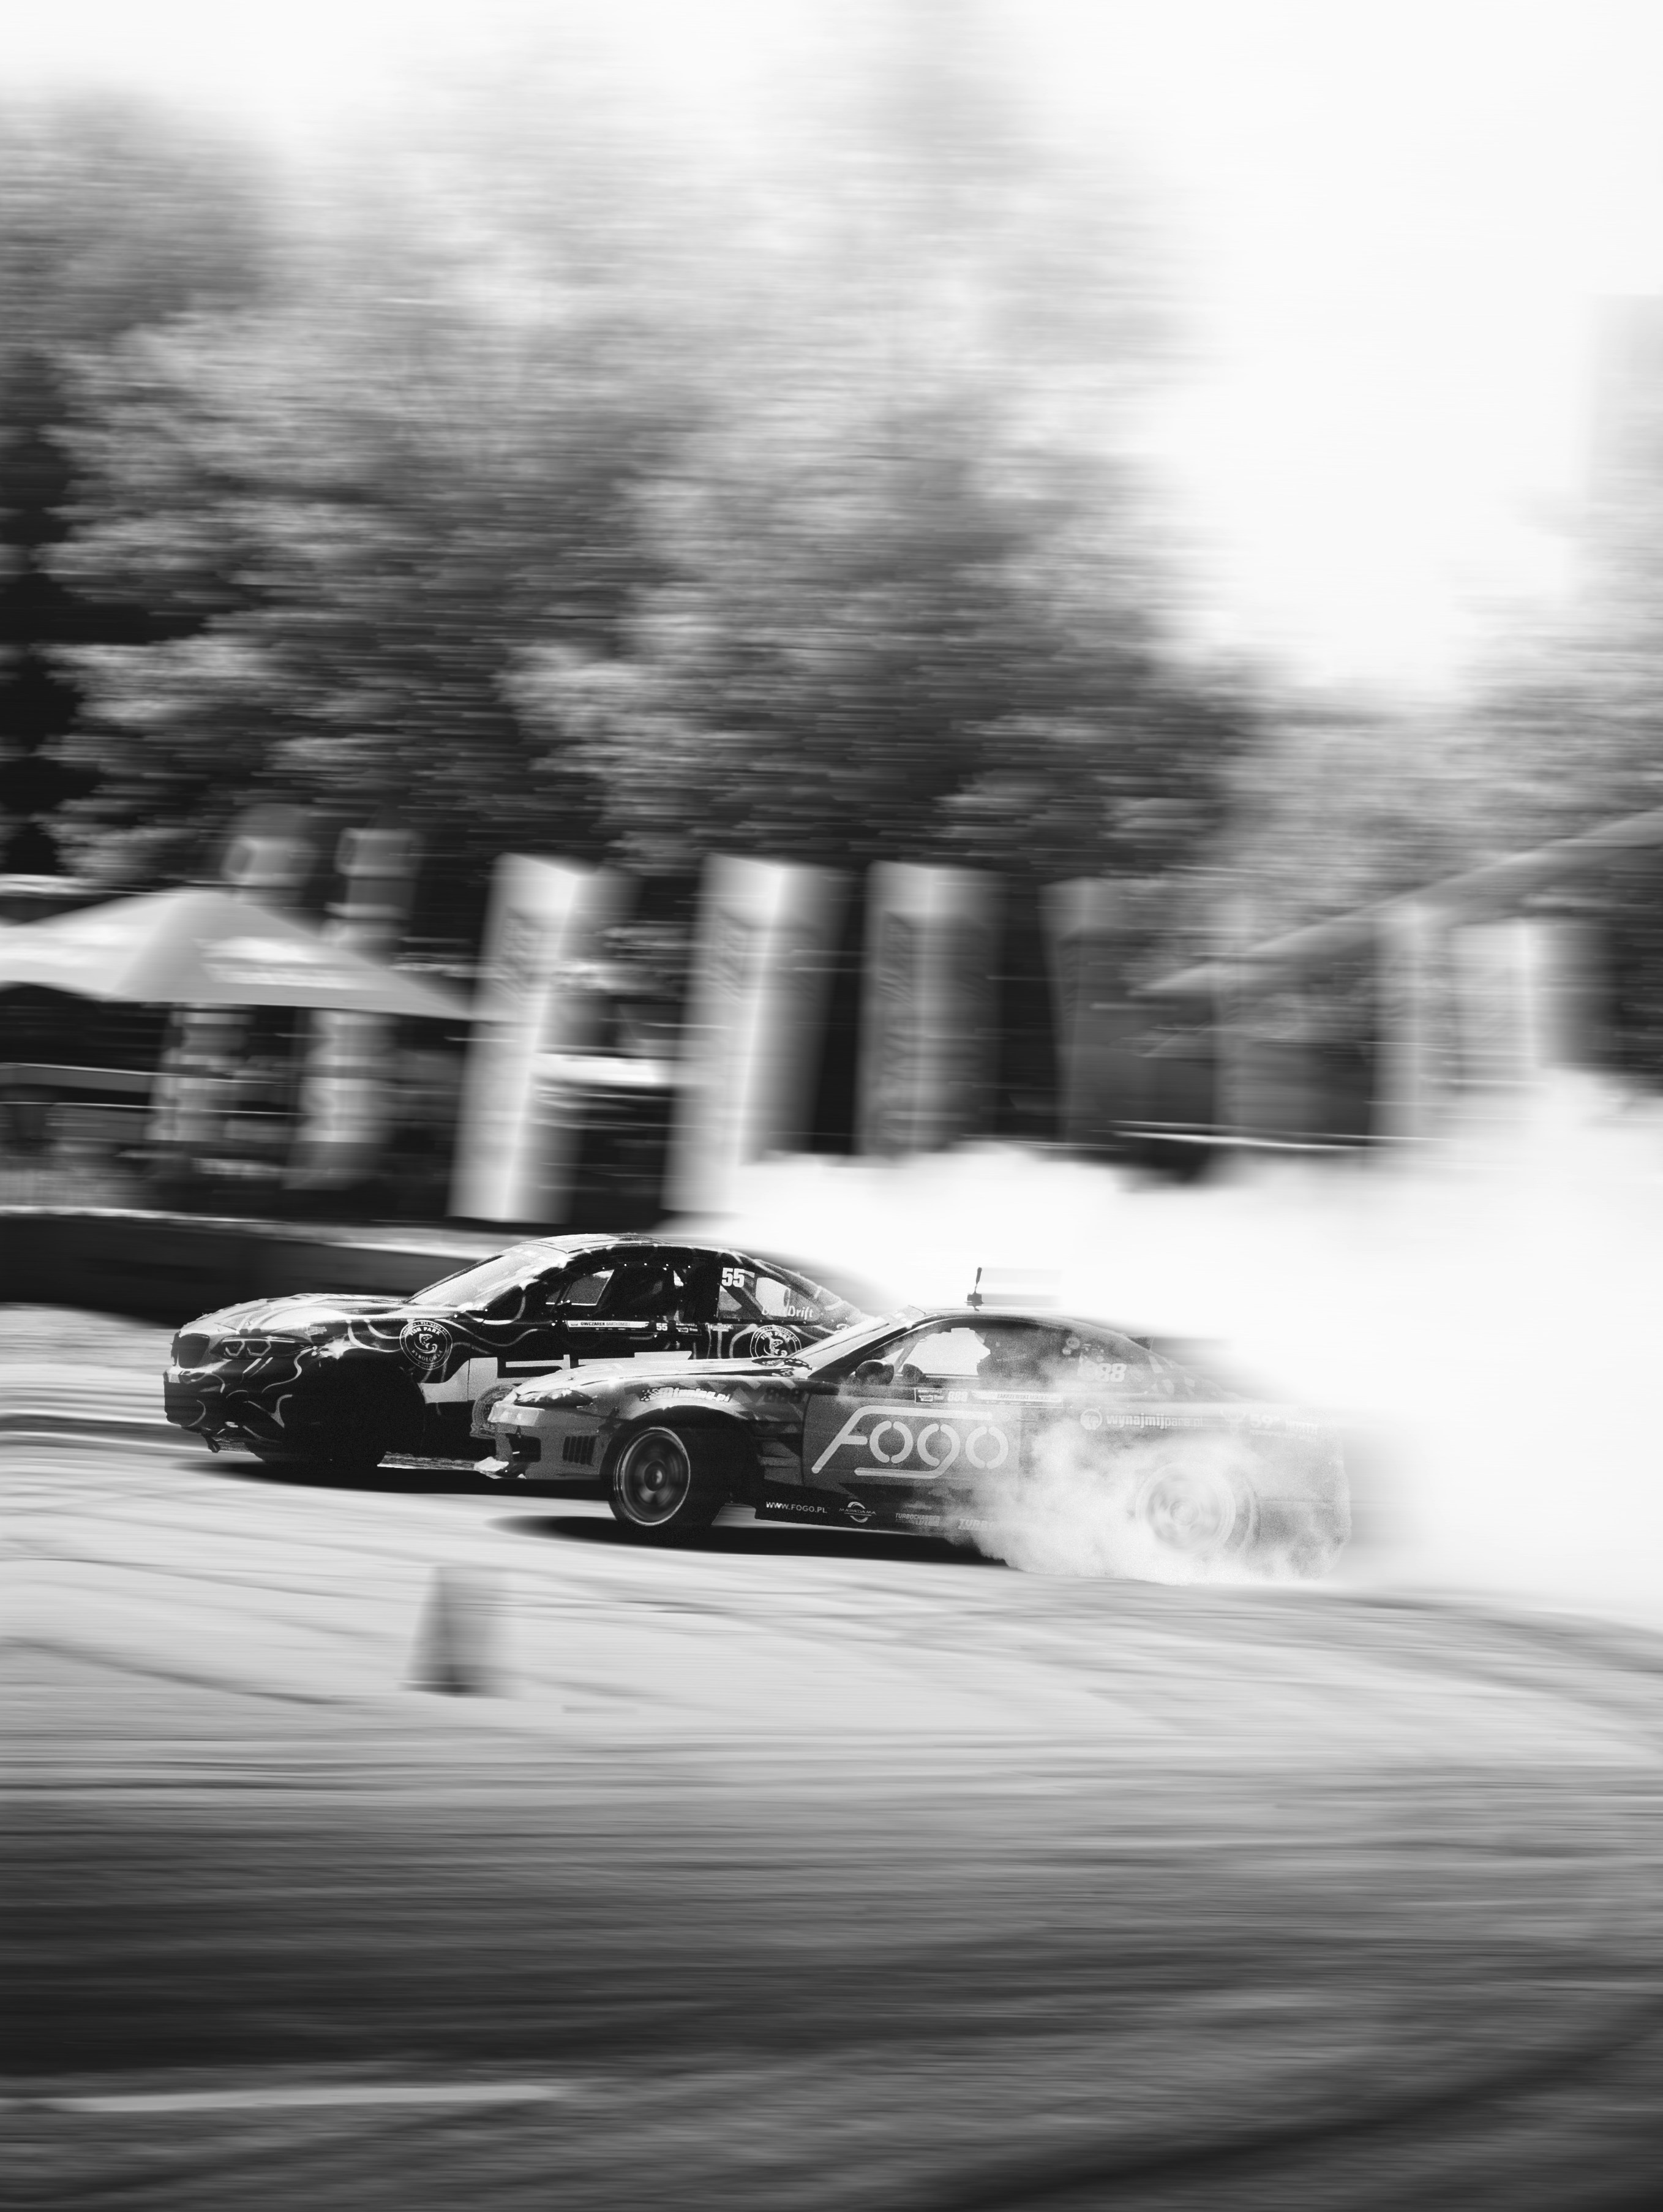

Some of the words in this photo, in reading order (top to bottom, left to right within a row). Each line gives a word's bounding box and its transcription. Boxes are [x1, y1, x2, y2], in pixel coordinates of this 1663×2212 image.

[721, 1267, 745, 1288] 55
[787, 1305, 814, 1320] Drift
[423, 1326, 441, 1336] PARK
[656, 1323, 668, 1331] 55
[766, 1501, 827, 1514] WWW.FOGO.PL
